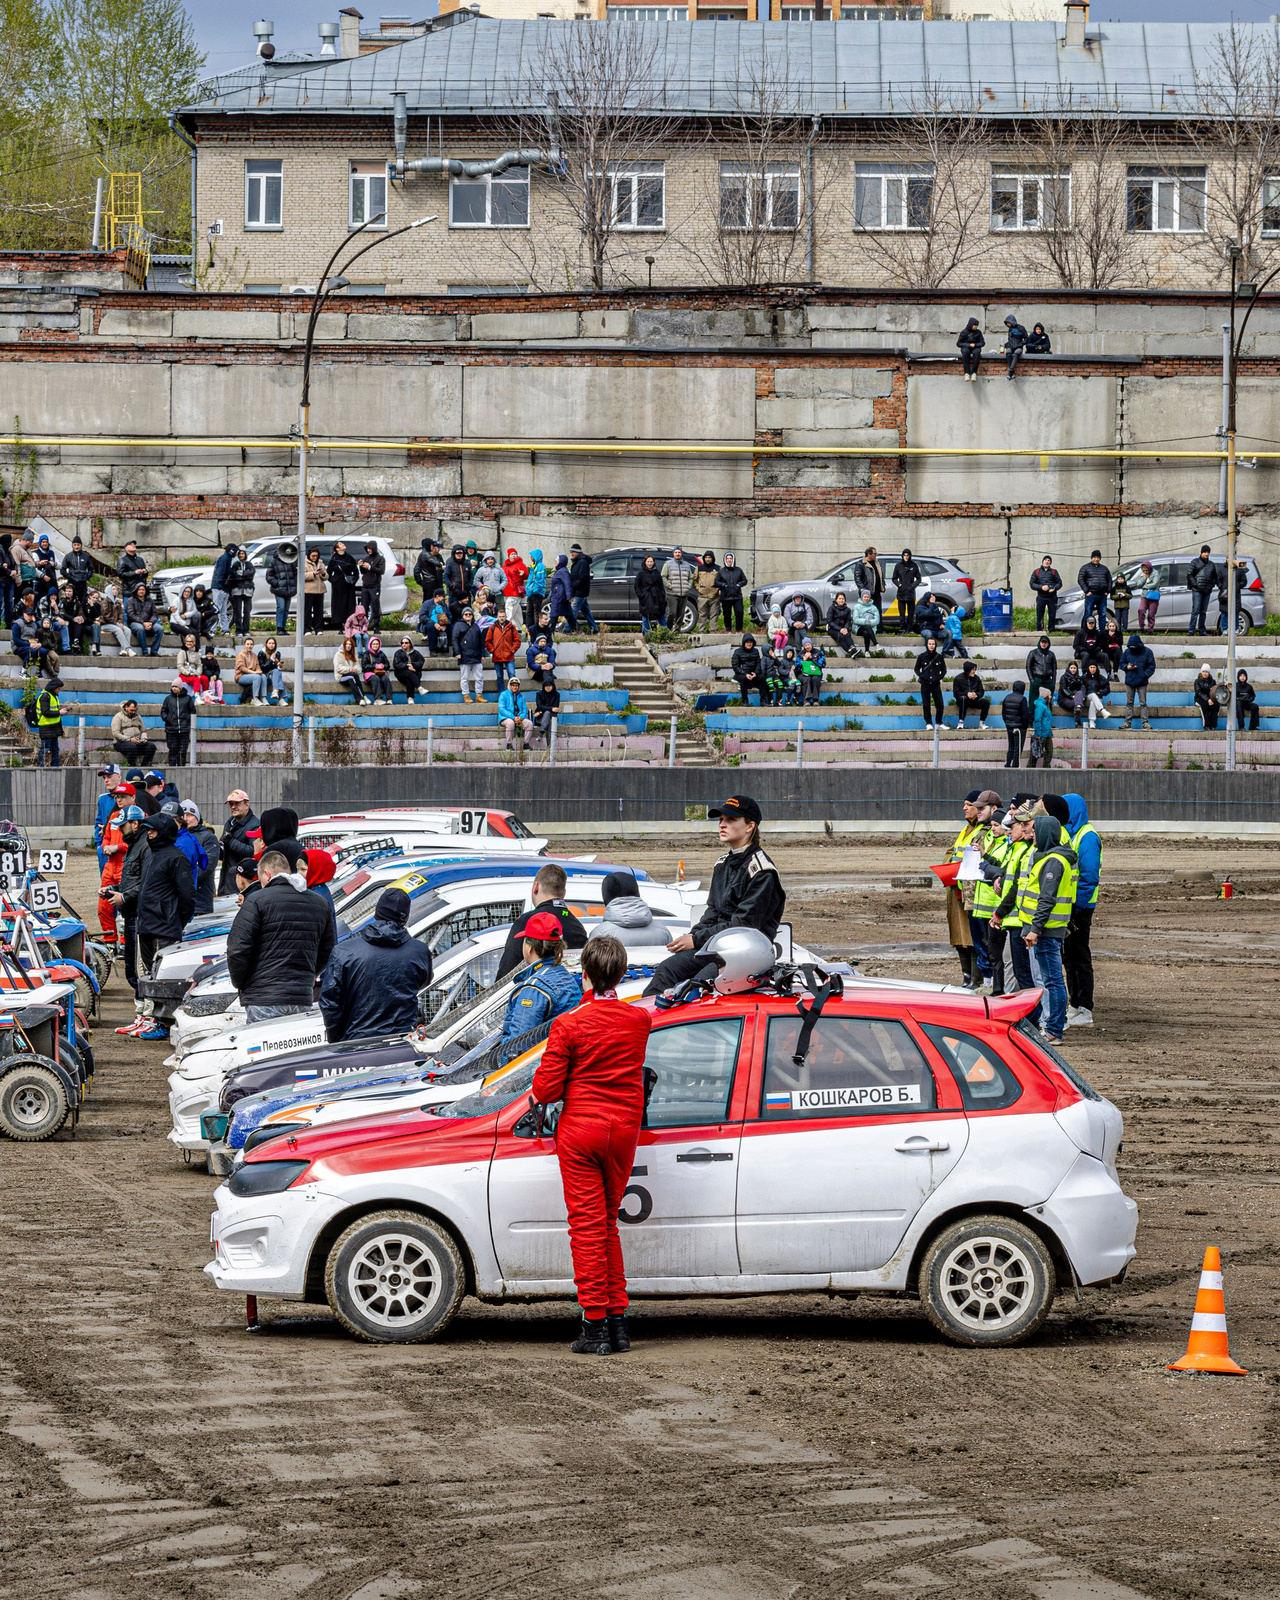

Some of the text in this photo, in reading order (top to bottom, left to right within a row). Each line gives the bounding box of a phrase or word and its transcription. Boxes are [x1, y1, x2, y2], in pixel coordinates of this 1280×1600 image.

[461, 810, 486, 835] 97
[1, 851, 26, 874] 81
[42, 852, 63, 871] 33
[34, 886, 58, 906] 55
[262, 1033, 322, 1052] Перевозников
[799, 1087, 914, 1107] КОШКАРОВ Б.
[617, 1164, 653, 1225] 5
